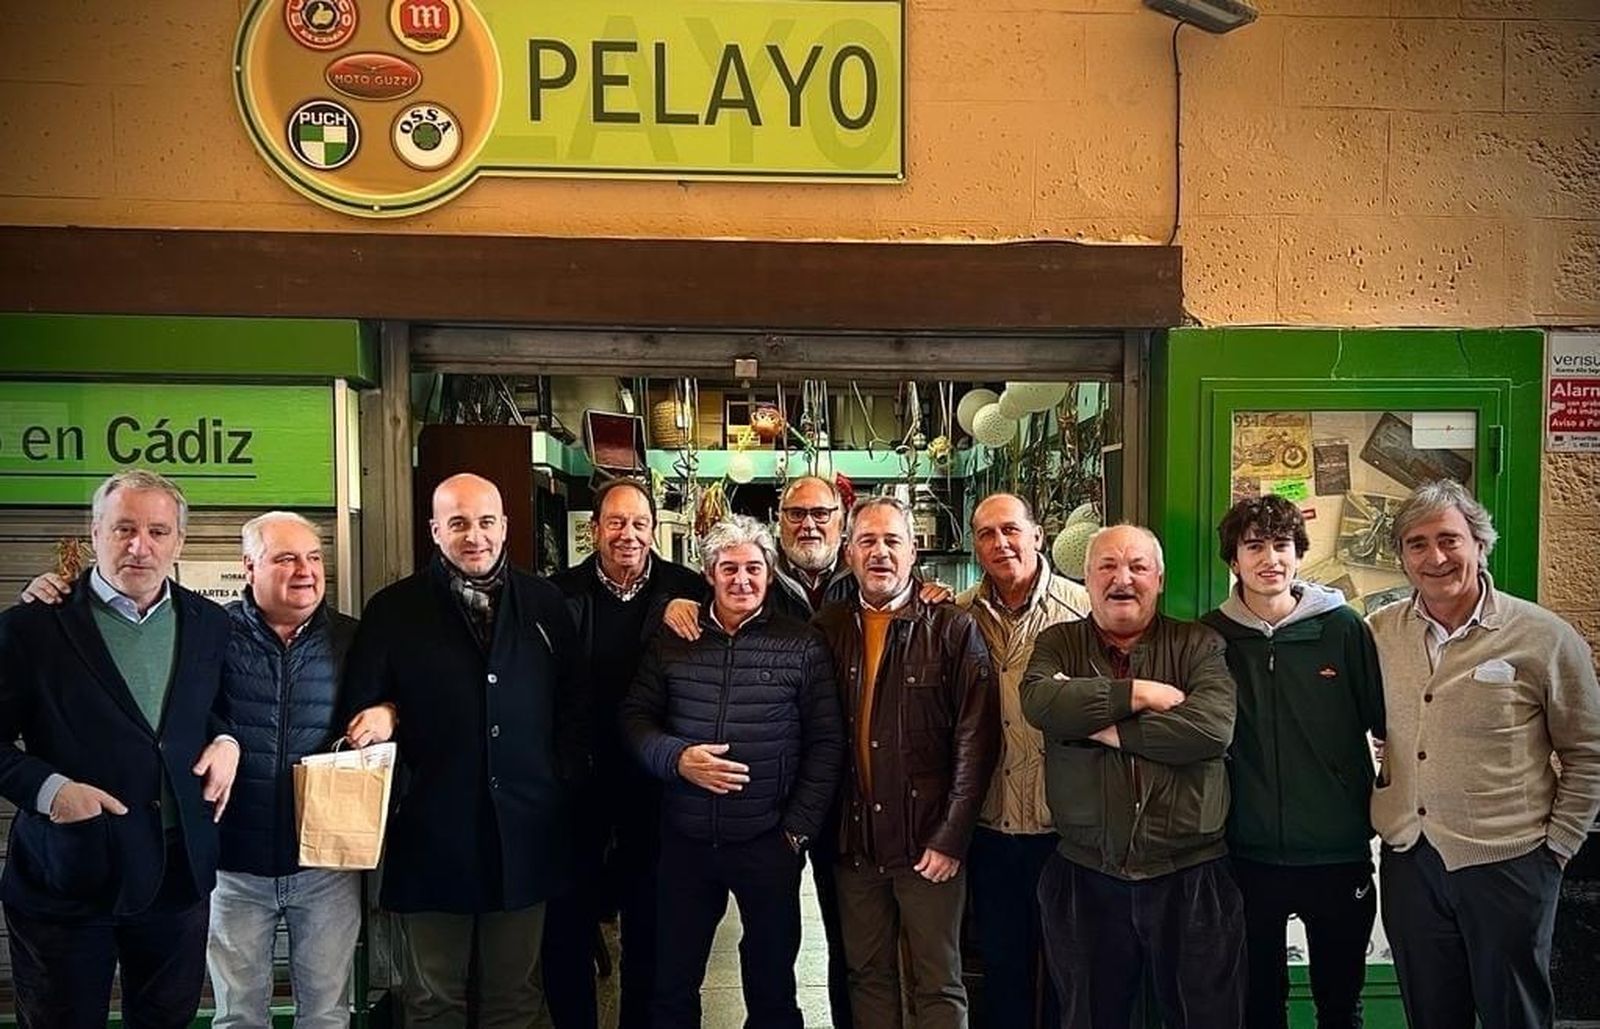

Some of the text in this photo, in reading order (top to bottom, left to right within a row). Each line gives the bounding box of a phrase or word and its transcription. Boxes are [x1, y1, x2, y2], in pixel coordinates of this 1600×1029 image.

[334, 74, 413, 87] MOTO GUZZI
[527, 38, 879, 131] PELAYO
[299, 111, 348, 126] PUCH
[400, 108, 453, 135] OSSA
[22, 415, 254, 465] en Cádiz
[232, 590, 239, 598] A
